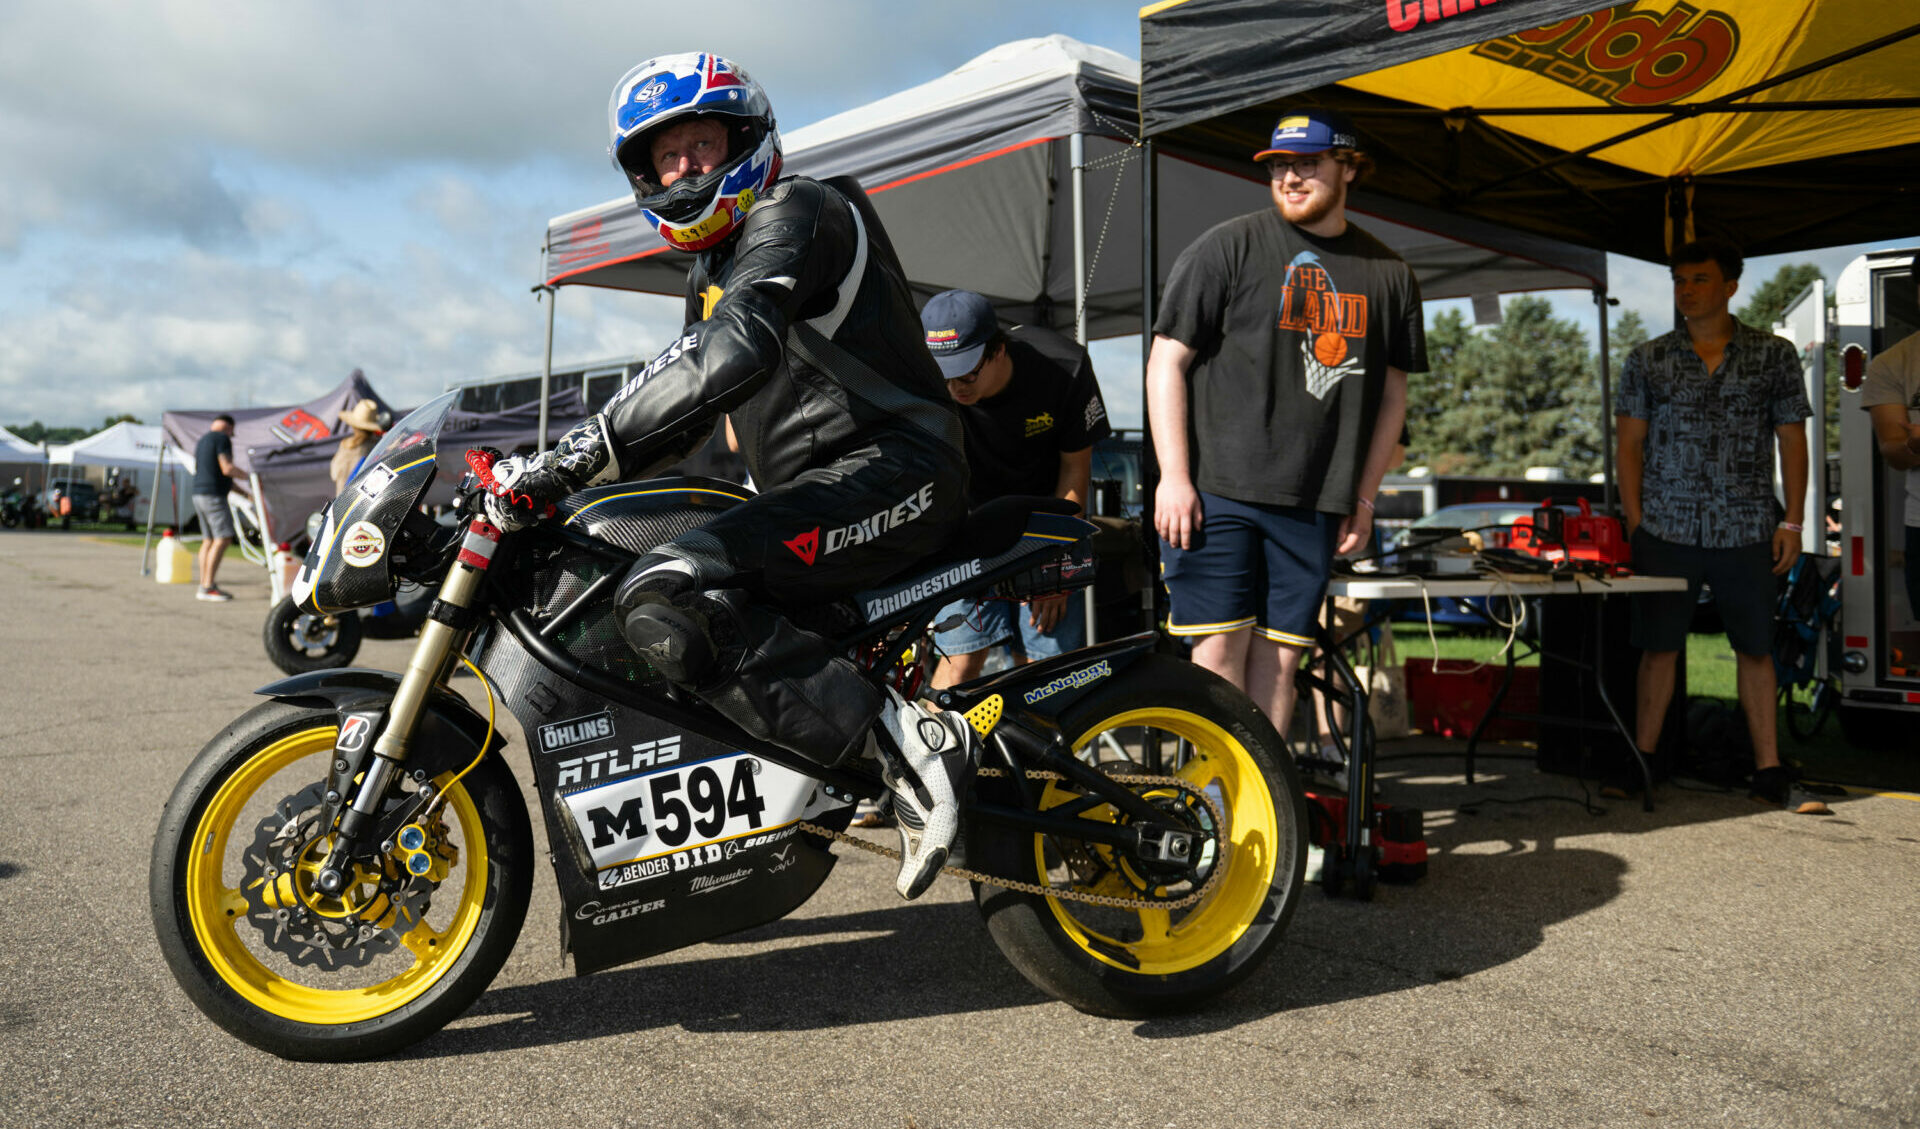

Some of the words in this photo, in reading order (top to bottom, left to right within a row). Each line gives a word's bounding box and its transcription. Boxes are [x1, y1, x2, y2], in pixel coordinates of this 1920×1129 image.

[681, 223, 709, 241] 594
[1285, 266, 1326, 290] THE
[1279, 286, 1367, 338] LAND
[867, 558, 982, 624] BRIDGESTONE
[1024, 660, 1108, 704] McNology
[544, 717, 610, 749] ÖHLINS
[558, 735, 681, 787] ATLAS
[586, 797, 649, 849] M
[649, 757, 766, 847] 594
[623, 858, 670, 881] BENDER
[744, 825, 800, 849] BOEING
[689, 868, 753, 892] Milwaukee
[593, 899, 666, 926] GALFER
